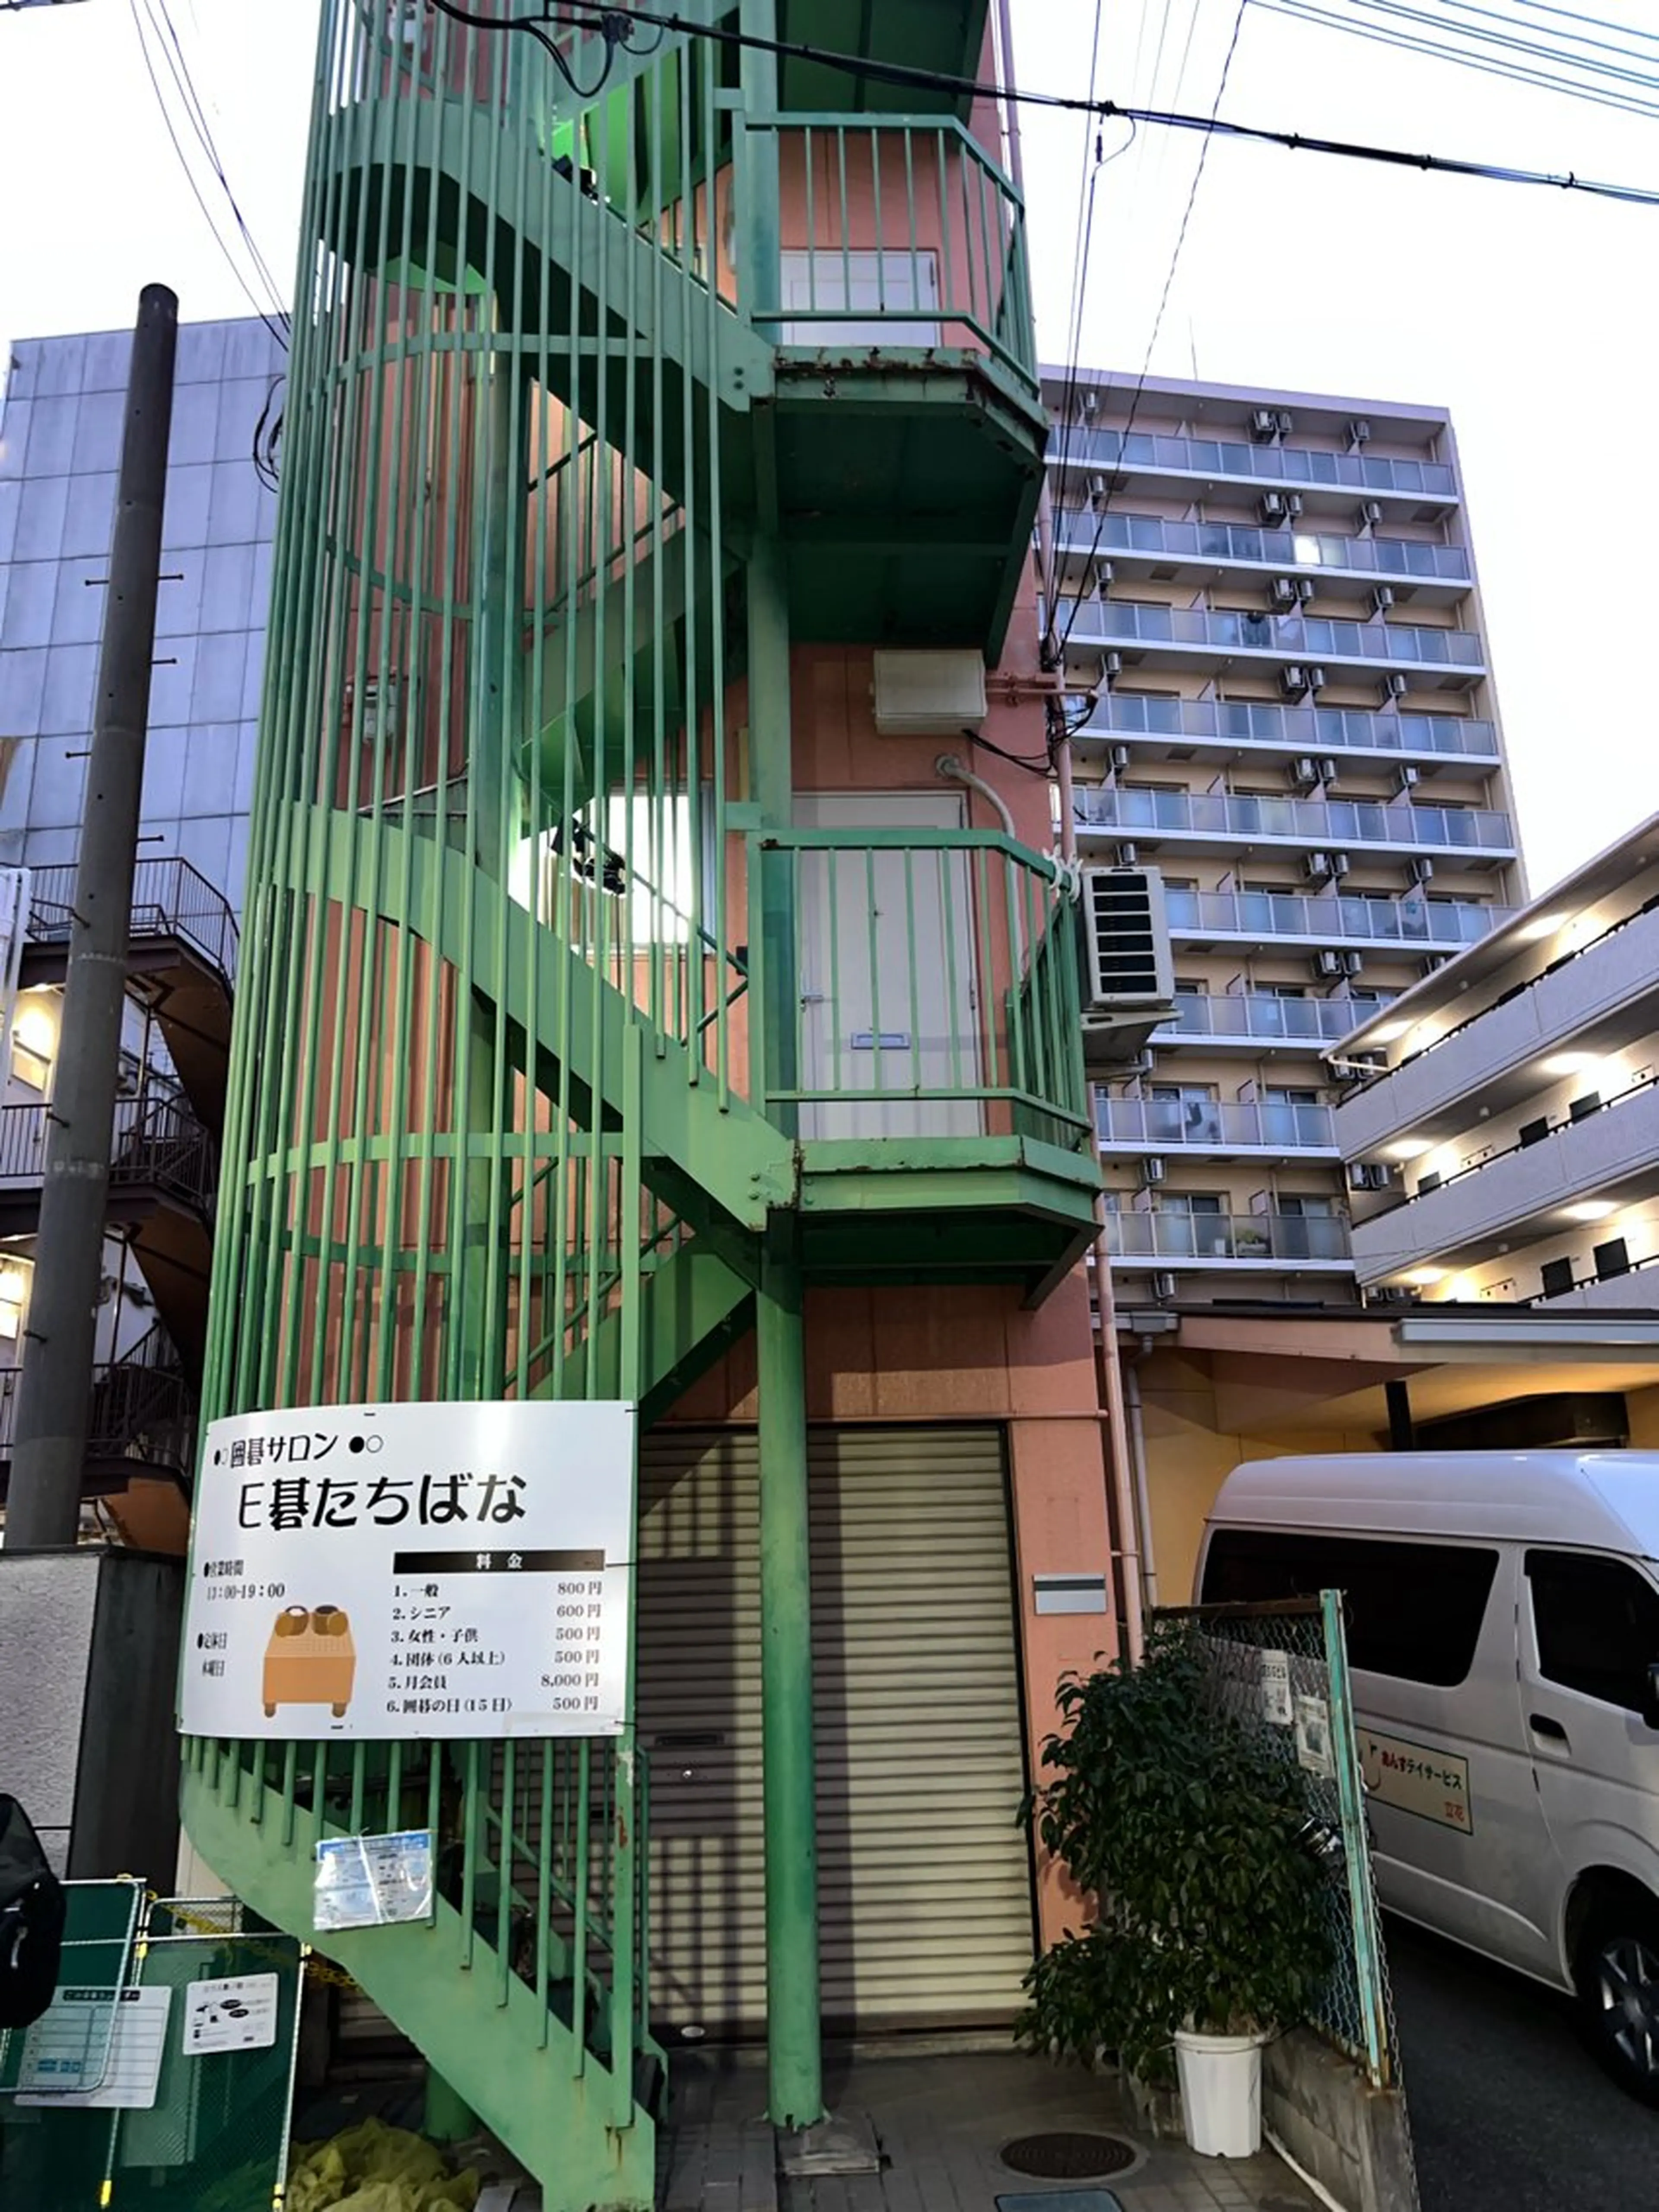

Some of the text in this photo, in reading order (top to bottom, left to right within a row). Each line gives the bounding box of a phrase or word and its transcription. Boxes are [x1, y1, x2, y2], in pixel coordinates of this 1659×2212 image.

[230, 1433, 339, 1468] 囲碁サロン
